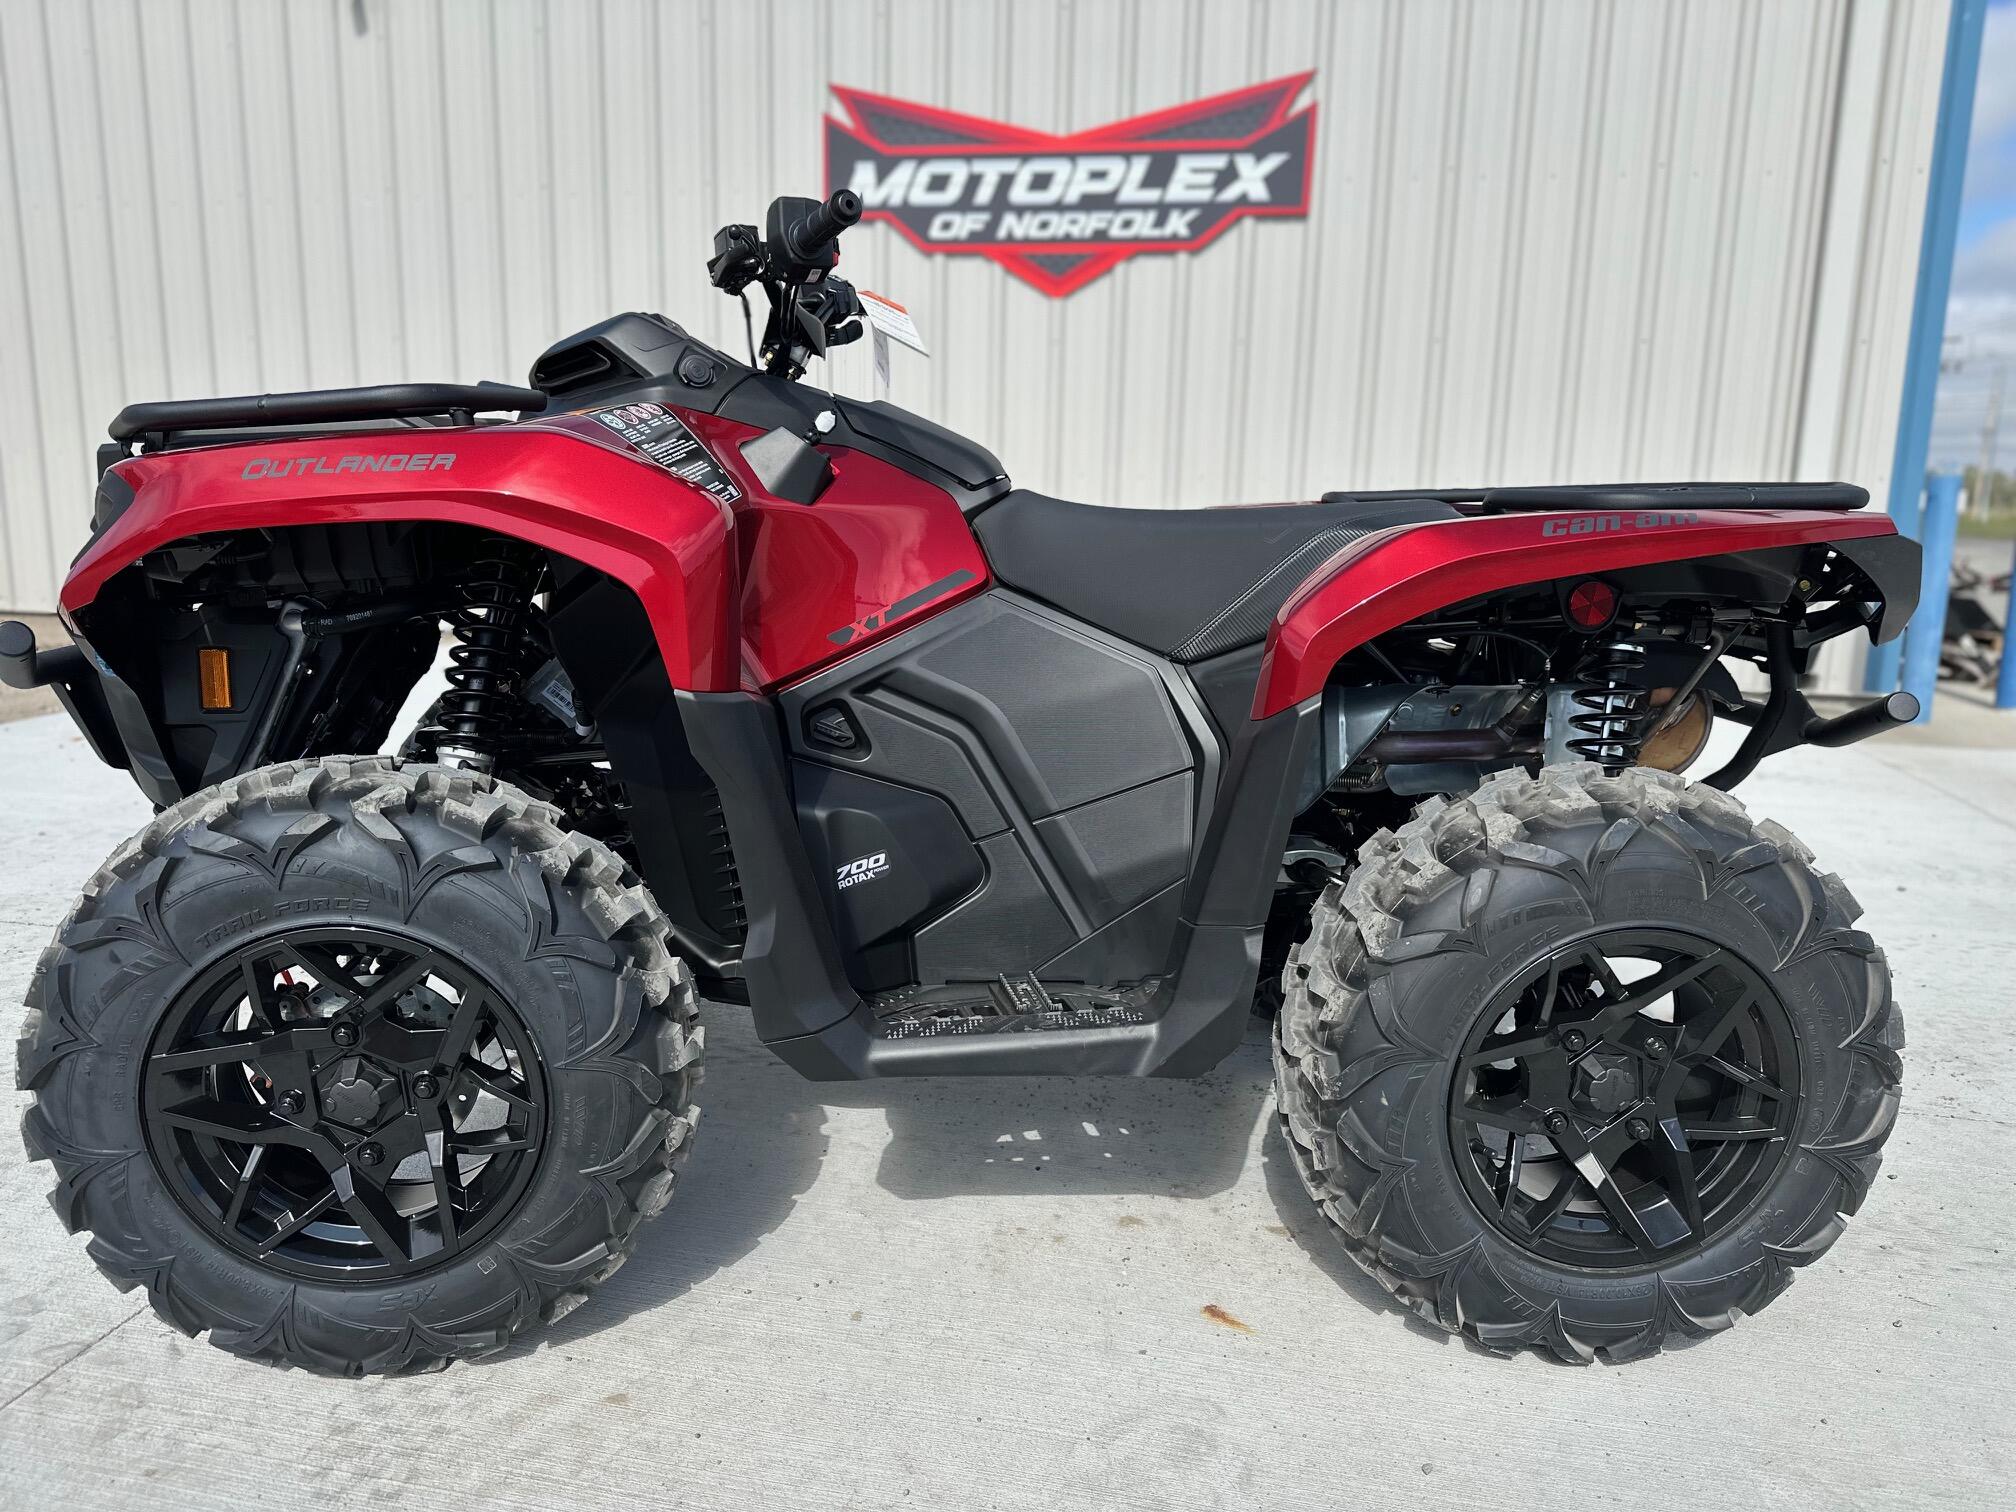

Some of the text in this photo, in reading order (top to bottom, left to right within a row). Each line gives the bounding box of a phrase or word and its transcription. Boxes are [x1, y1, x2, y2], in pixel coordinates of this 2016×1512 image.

[848, 152, 1291, 207] MOTOPLEX
[929, 208, 1203, 240] OF NORFOLK
[241, 453, 457, 480] OUTLANDER
[849, 604, 892, 640] XT
[836, 853, 886, 880] 700
[837, 869, 875, 890] ROTAX
[194, 897, 370, 949] TRAIL FORCE
